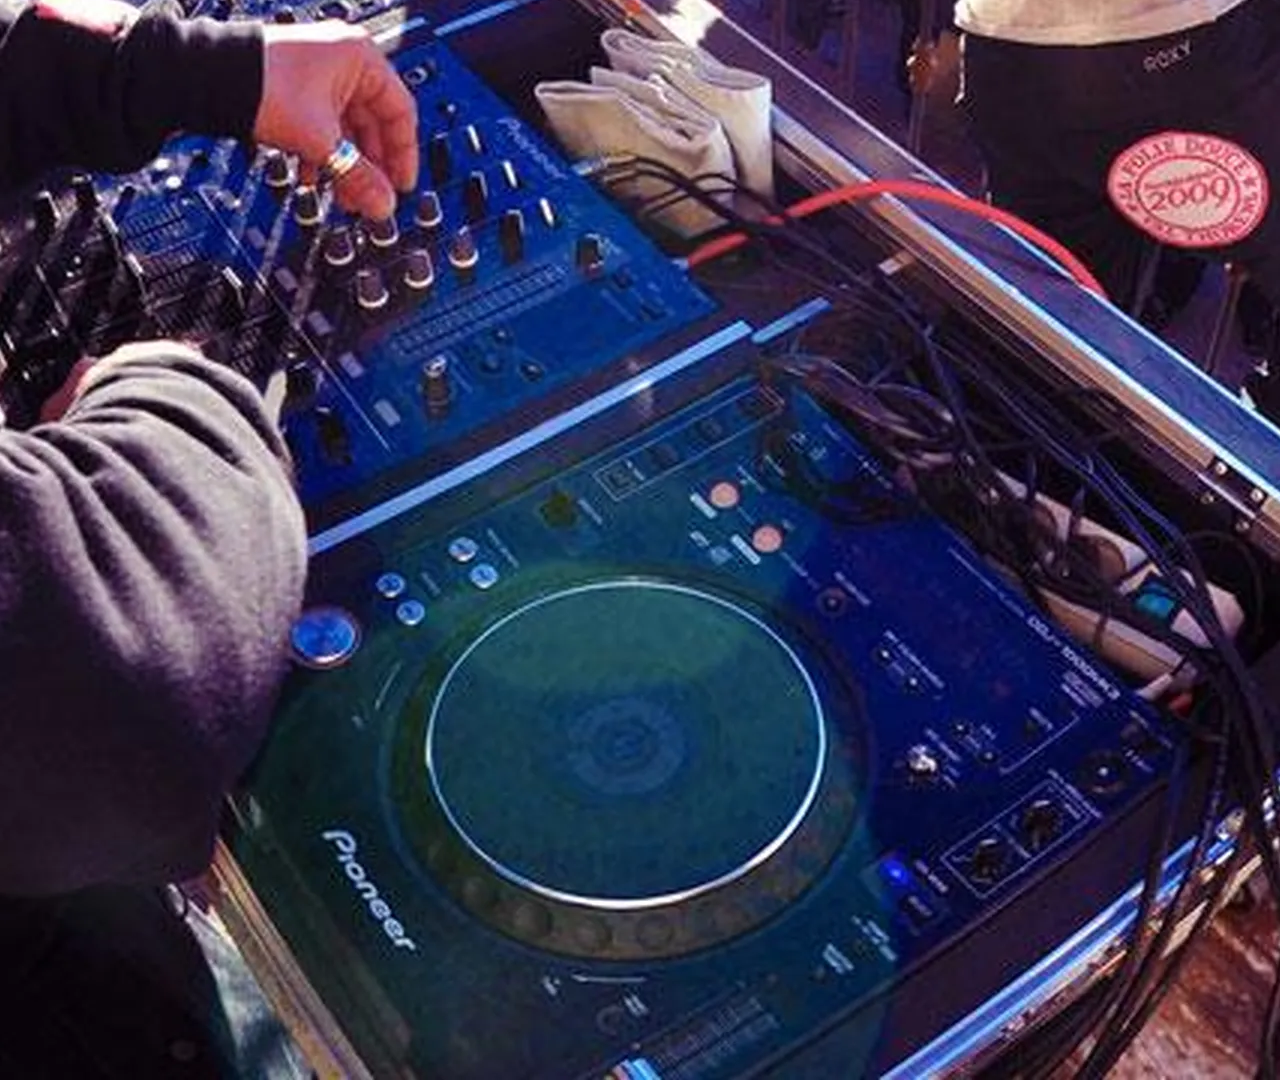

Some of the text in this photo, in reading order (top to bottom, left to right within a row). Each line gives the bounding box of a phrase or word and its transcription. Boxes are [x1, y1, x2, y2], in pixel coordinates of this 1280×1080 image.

[1143, 39, 1191, 73] ROXY
[1122, 137, 1176, 178] FOLIE
[1185, 136, 1250, 174] DOUCE
[1147, 175, 1230, 212] 2009
[321, 829, 416, 951] Pioneer
